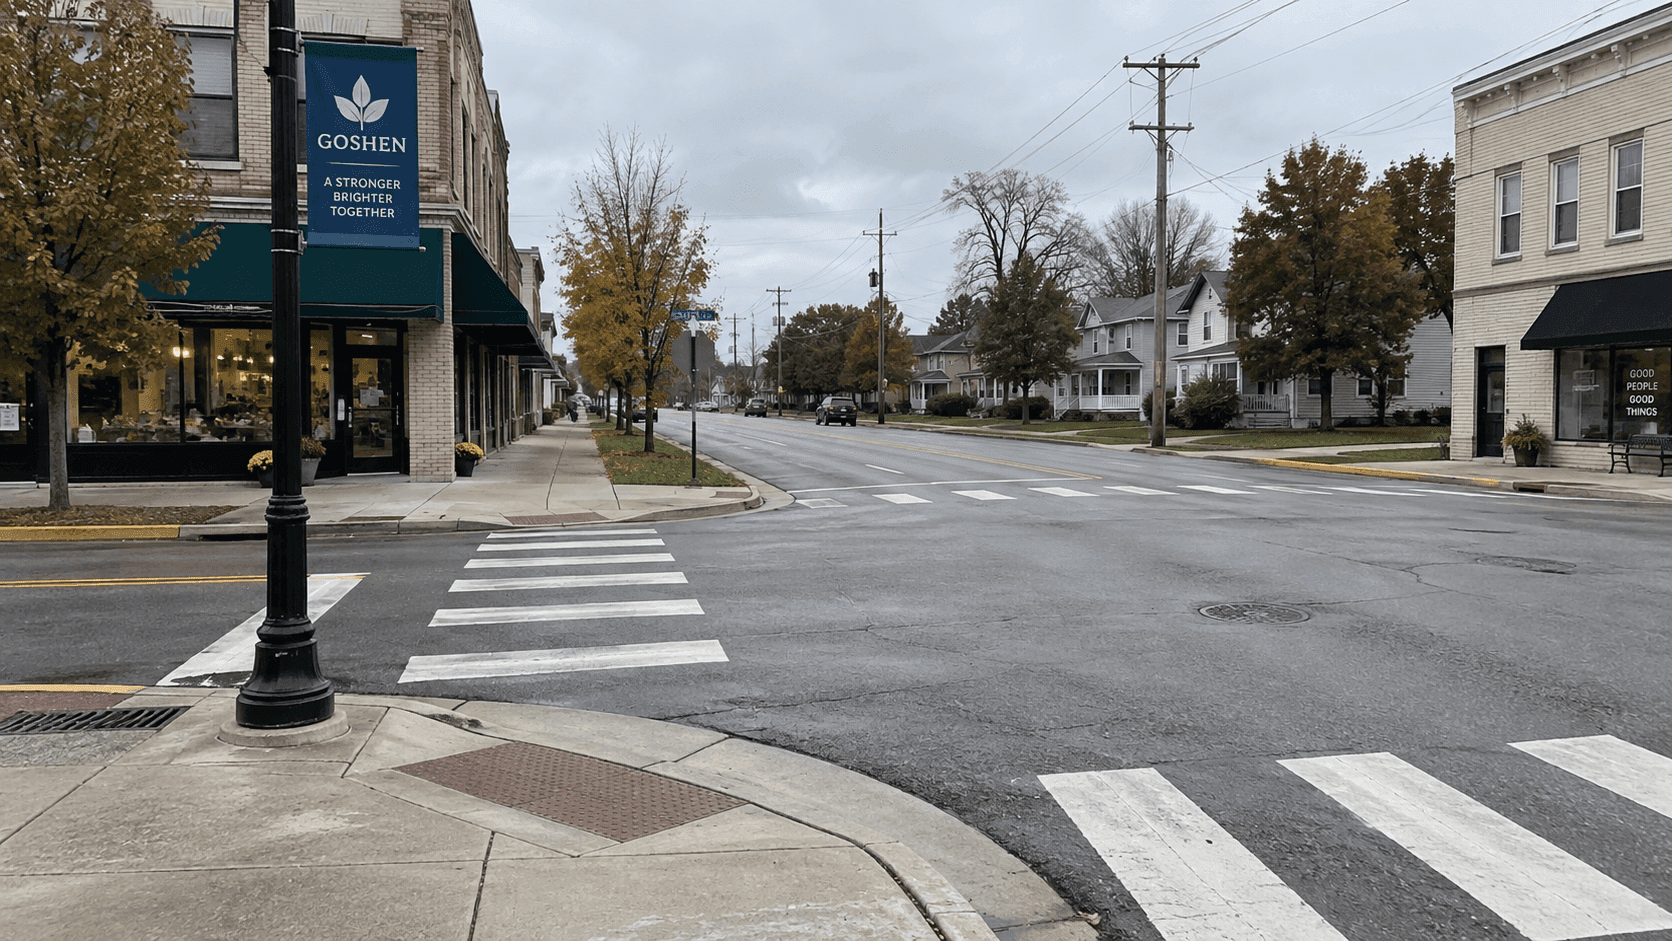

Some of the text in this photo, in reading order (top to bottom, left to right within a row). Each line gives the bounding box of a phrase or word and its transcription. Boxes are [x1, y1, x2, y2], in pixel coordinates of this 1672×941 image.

[317, 133, 406, 153] GOSHEN
[323, 176, 401, 190] A STRONGER
[333, 191, 393, 204] BRIGHTER
[330, 205, 395, 218] TOGETHER
[1629, 368, 1655, 378] GOOD
[1626, 381, 1659, 391] PEOPLE
[1629, 394, 1655, 404] GOOD
